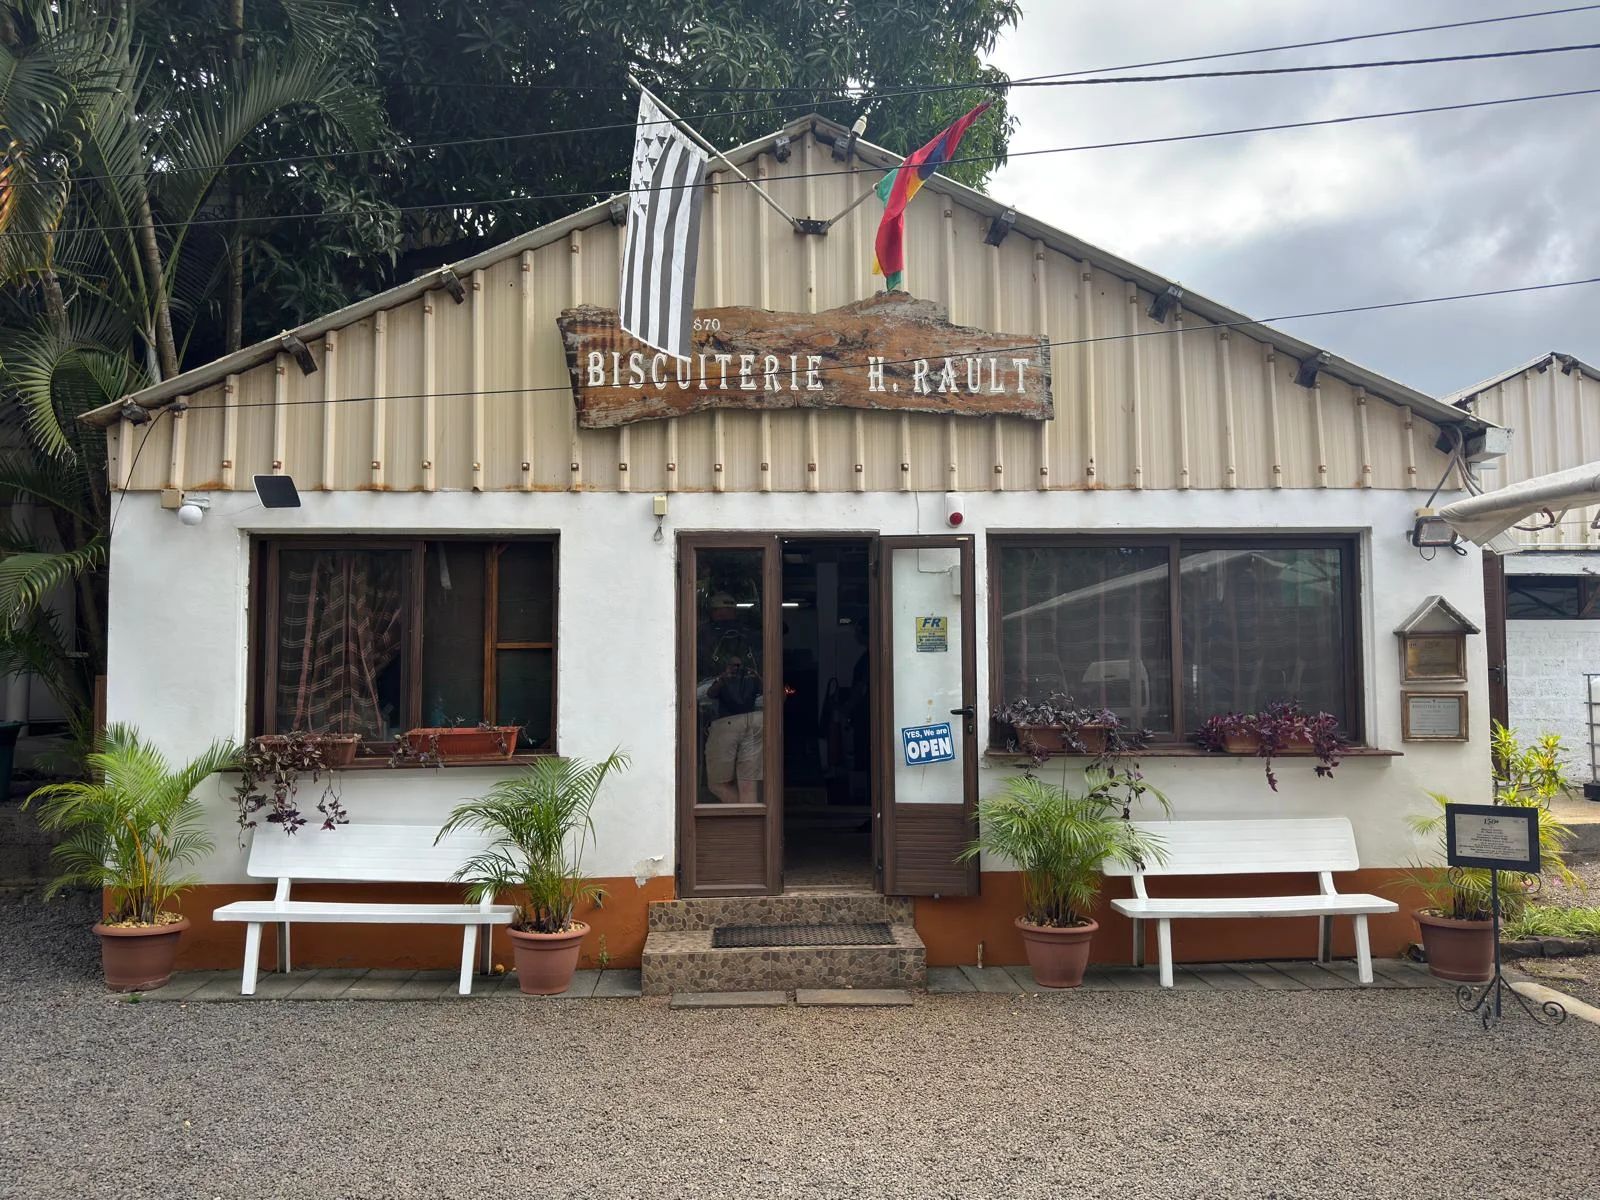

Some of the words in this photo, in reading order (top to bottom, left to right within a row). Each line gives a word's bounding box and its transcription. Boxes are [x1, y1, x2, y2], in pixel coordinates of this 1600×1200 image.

[587, 351, 824, 394] BISCUITERIE
[867, 356, 899, 393] H.
[913, 358, 1030, 396] RAULT
[922, 616, 941, 628] FR
[906, 730, 923, 739] YES,
[923, 729, 935, 737] We
[907, 736, 952, 760] OPEN
